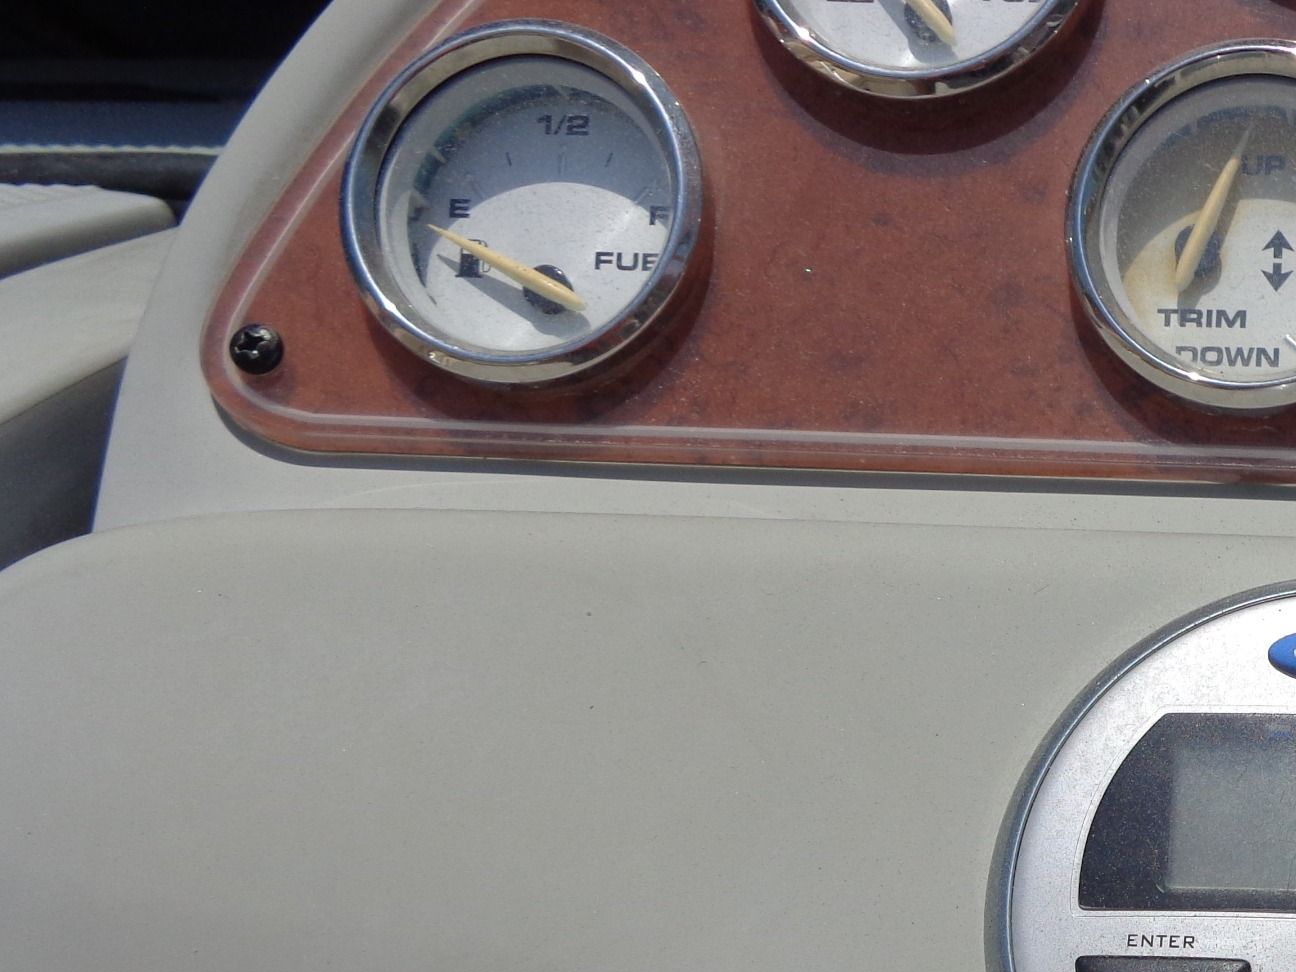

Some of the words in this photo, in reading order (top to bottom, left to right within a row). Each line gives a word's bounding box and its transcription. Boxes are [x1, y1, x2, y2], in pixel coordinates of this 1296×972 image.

[536, 114, 590, 136] 1/2
[1240, 154, 1286, 176] UP
[449, 198, 471, 219] E
[1157, 308, 1248, 329] TRIM
[1175, 345, 1280, 368] DOWN
[1126, 934, 1195, 949] ENTER
